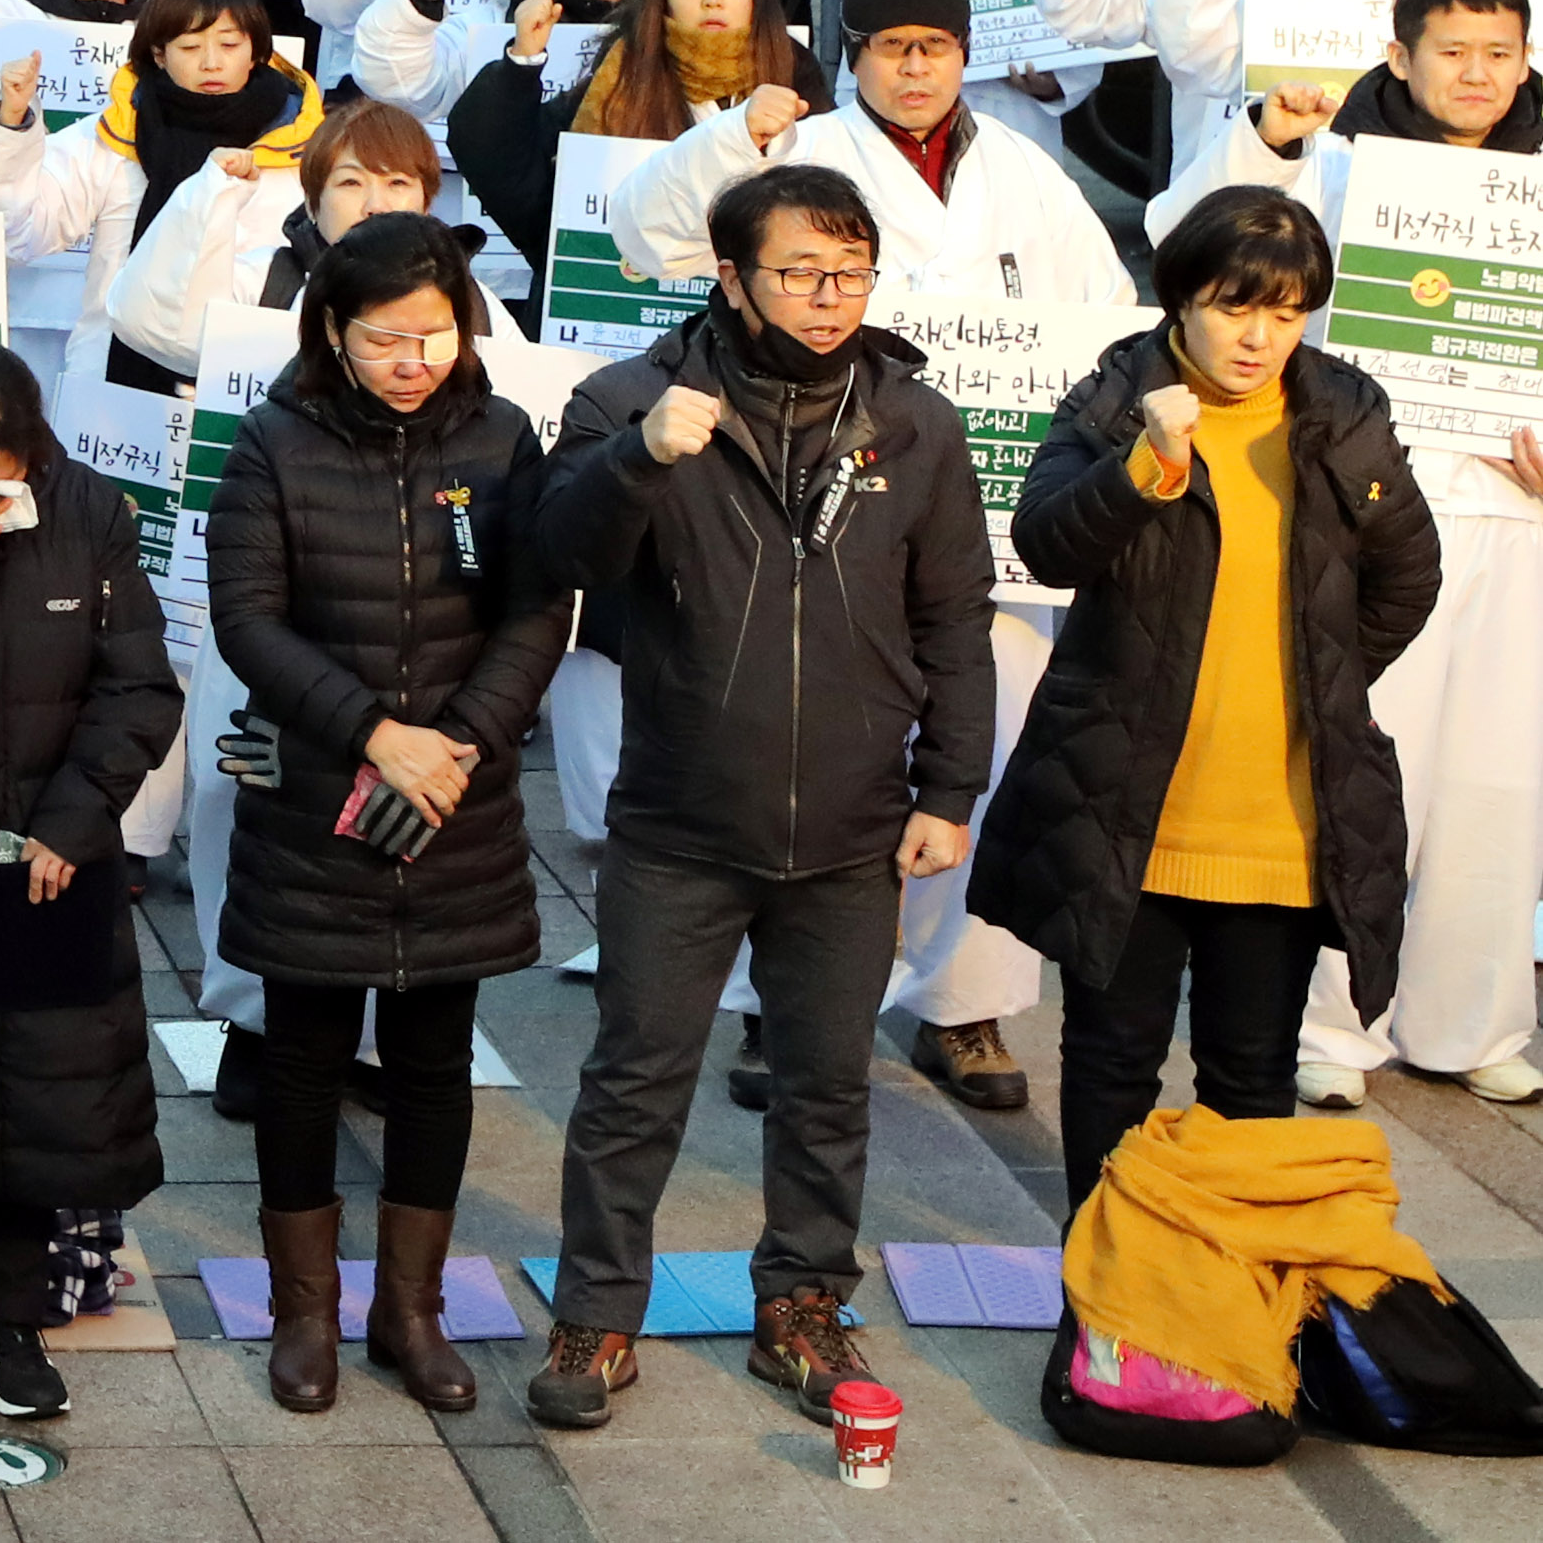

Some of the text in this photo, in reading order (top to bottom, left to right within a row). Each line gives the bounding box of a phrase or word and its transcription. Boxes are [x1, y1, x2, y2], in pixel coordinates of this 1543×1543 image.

[1273, 25, 1364, 64] 비정규직
[1375, 203, 1476, 249] 비정규직
[559, 325, 578, 343] 나
[1430, 334, 1539, 367] 정규직전환은
[966, 411, 1029, 434] 없애고!
[76, 432, 162, 478] 비정규직
[854, 475, 888, 493] K2
